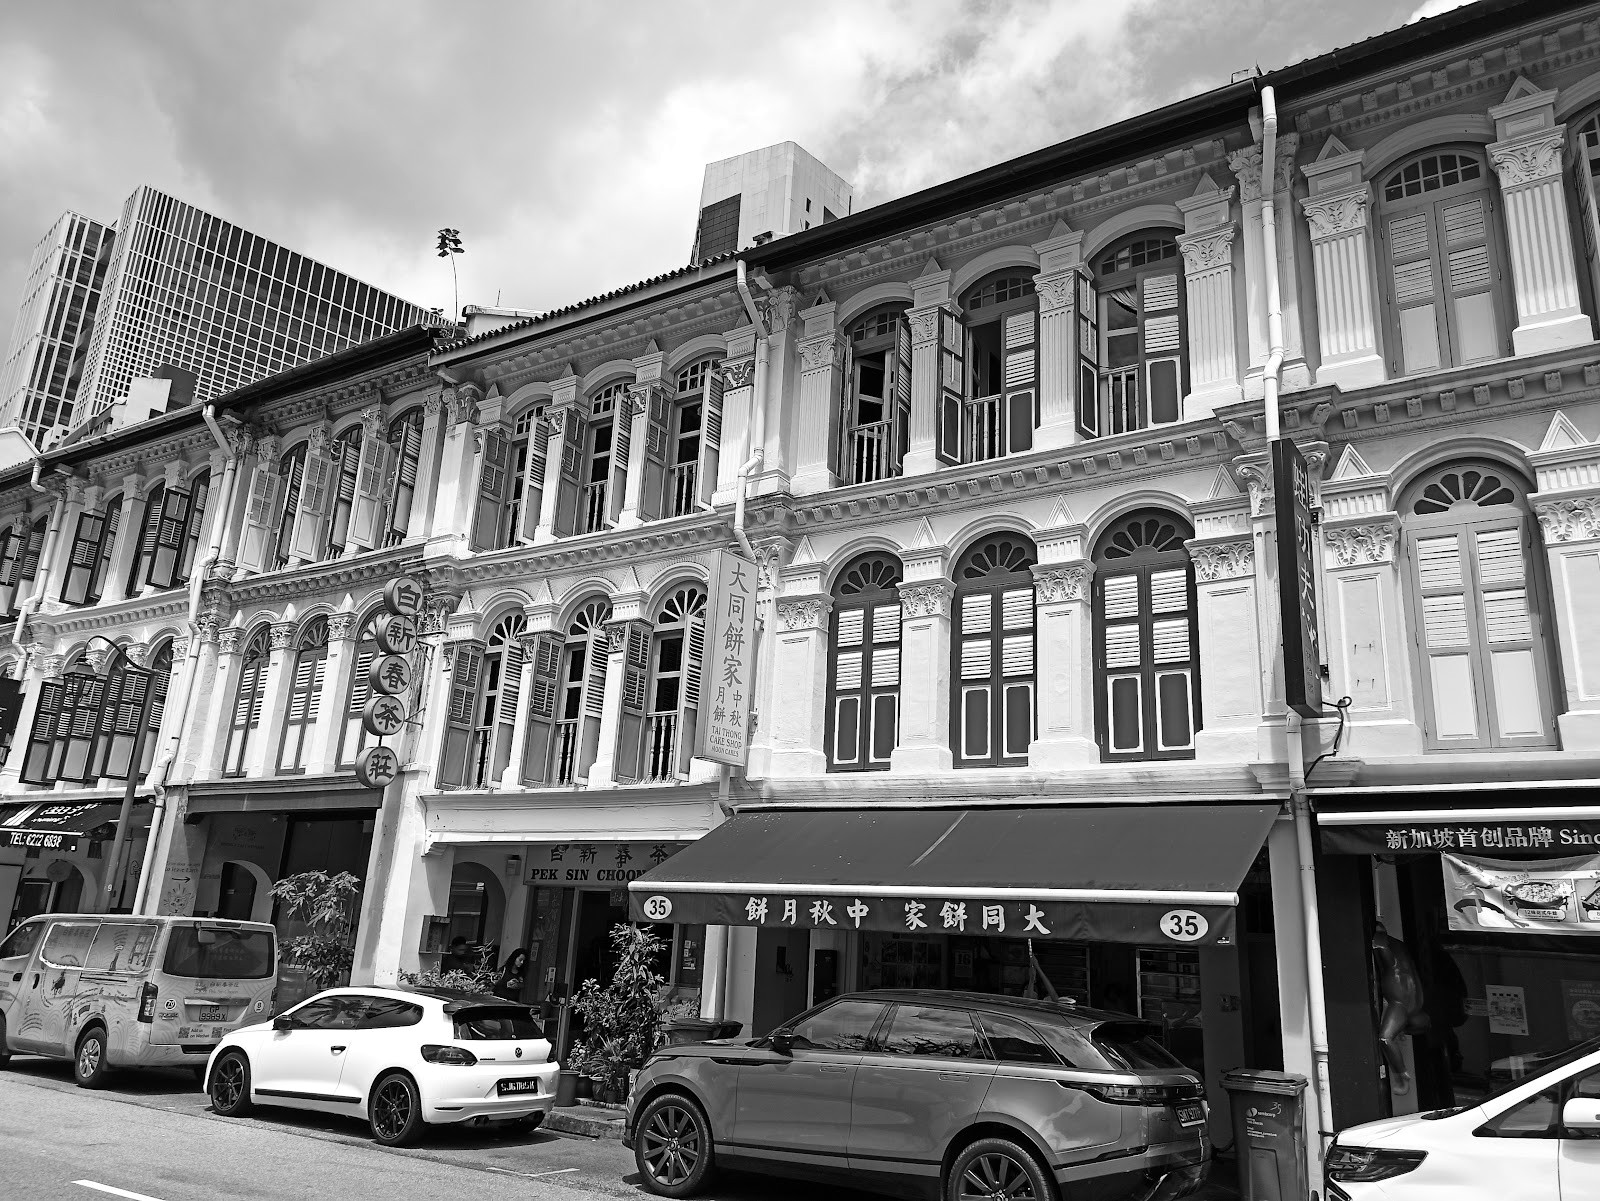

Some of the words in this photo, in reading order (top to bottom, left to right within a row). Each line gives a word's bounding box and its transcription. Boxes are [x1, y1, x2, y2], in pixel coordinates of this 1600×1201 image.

[722, 562, 750, 688] 大同餅家
[368, 584, 421, 780] 白新春茶莊
[712, 685, 726, 725] 月餅
[729, 689, 743, 728] 中秋
[709, 734, 725, 746] CAKE
[726, 737, 742, 749] SHOP
[711, 725, 721, 736] TAI
[721, 727, 742, 741] THONG
[1385, 826, 1555, 849] 新加坡首创品牌
[530, 868, 559, 880] PEK
[565, 869, 590, 881] SIN
[648, 899, 667, 916] 35
[1169, 914, 1199, 937] 35
[1270, 1101, 1282, 1115] 35
